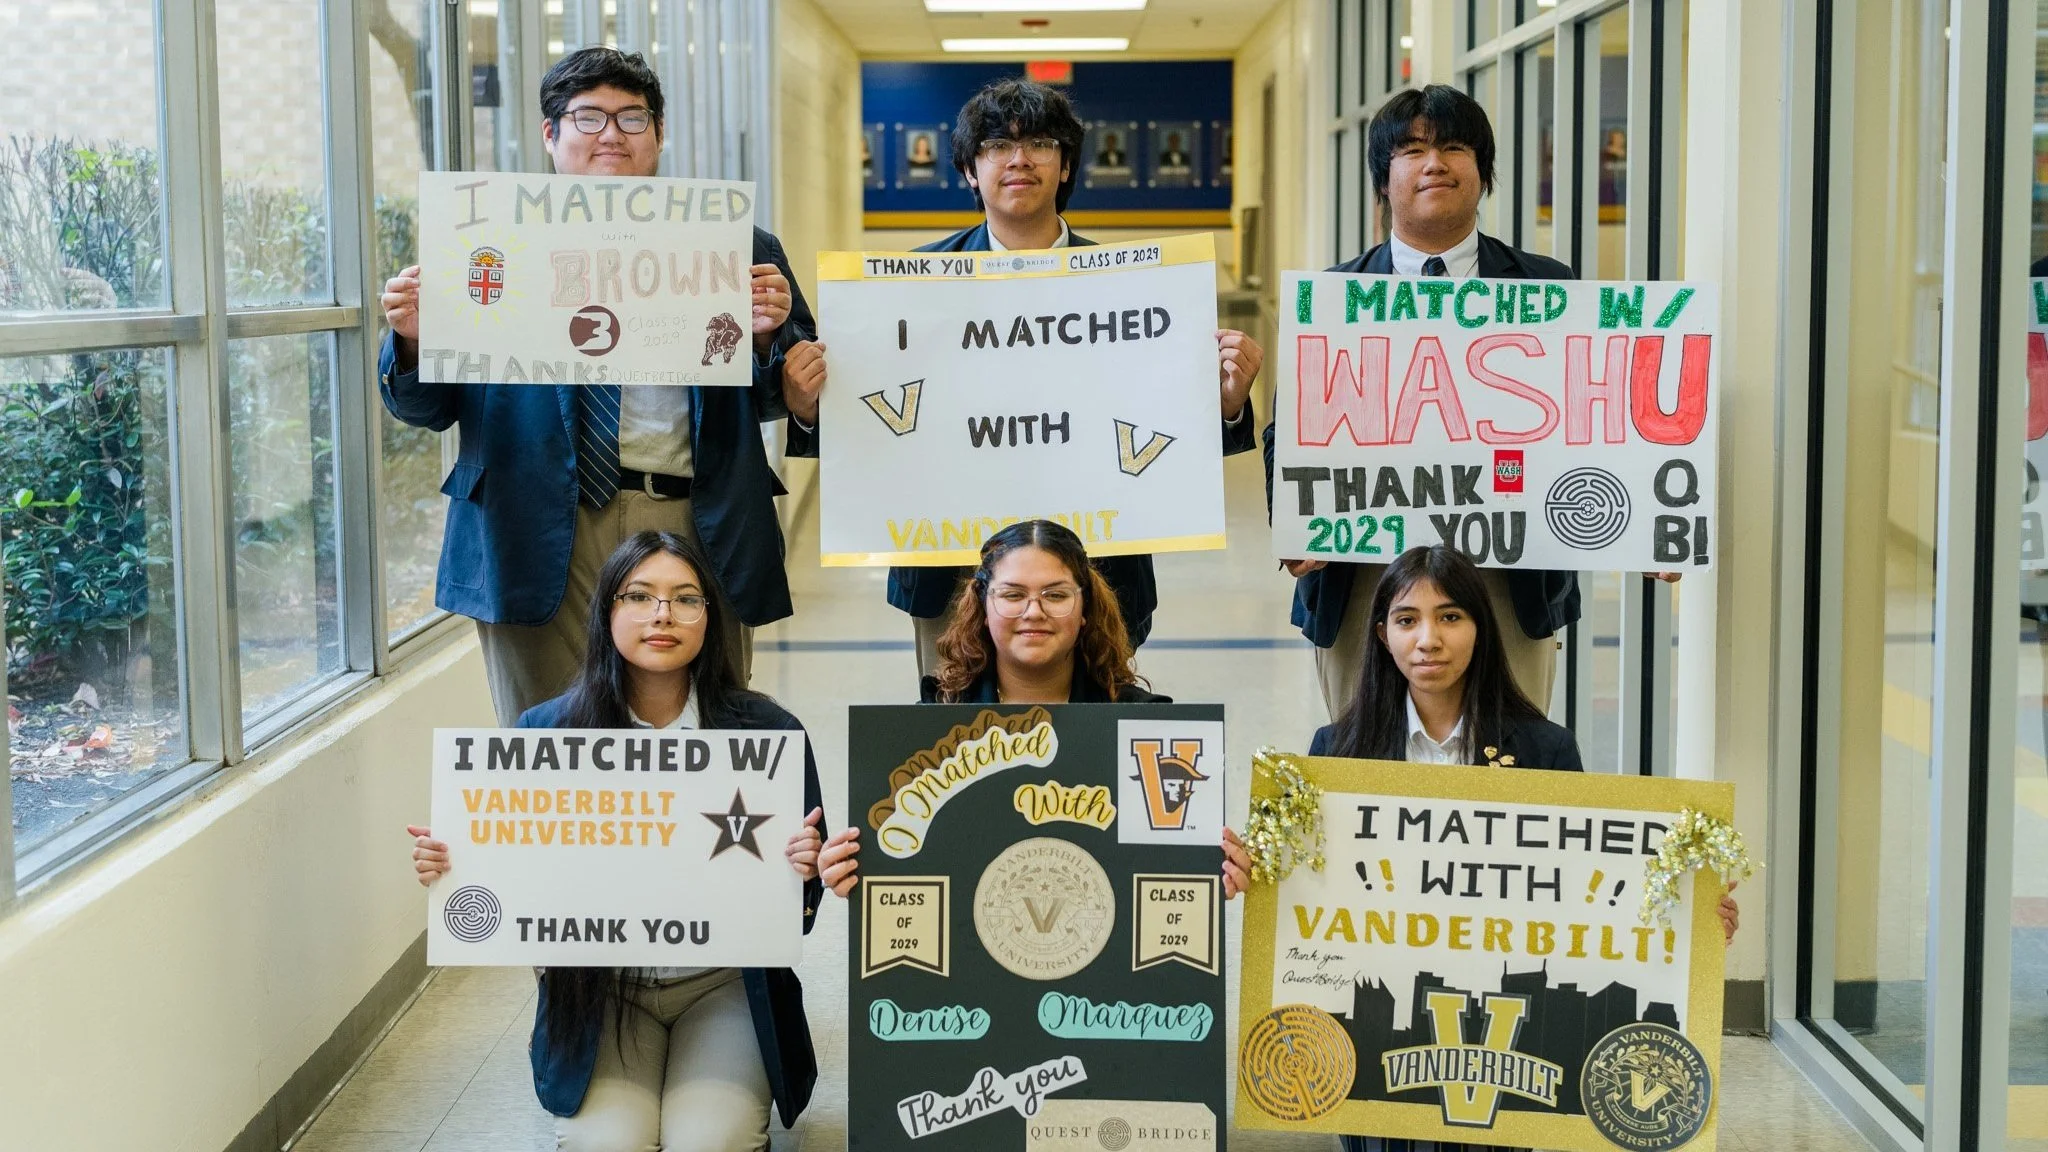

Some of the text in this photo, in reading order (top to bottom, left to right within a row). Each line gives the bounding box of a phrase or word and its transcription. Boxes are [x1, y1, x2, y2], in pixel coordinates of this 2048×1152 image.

[455, 180, 750, 229] I MATCHED
[602, 231, 636, 241] with
[550, 249, 741, 307] BROWN
[867, 258, 974, 275] THANK YOU
[1070, 247, 1159, 270] CLASS OF 2029
[628, 314, 689, 333] Class of
[1297, 280, 1312, 324] I
[1345, 279, 1567, 329] MATCHED
[642, 331, 680, 348] 2029
[898, 306, 1171, 350] I MATCHED
[422, 349, 607, 384] THANKS
[858, 378, 925, 437] V
[1297, 333, 1713, 446] WASHU
[967, 411, 1070, 448] WITH
[1112, 418, 1178, 477] V
[1281, 464, 1485, 516] THANK
[1496, 466, 1522, 476] WASH
[1653, 459, 1700, 508] Q
[1306, 511, 1526, 565] 2029 YOU
[1653, 514, 1710, 566] B!
[455, 735, 787, 780] I MATCHED W/
[900, 725, 1050, 819] Matched
[462, 788, 675, 817] VANDERBILT
[1018, 784, 1112, 824] With
[470, 820, 677, 847] UNIVERSITY
[726, 815, 749, 843] V
[1354, 805, 1669, 856] I MATCHED
[997, 847, 1093, 875] VANDERBILT
[1421, 860, 1561, 902] WITH
[879, 893, 925, 906] CLASS
[1149, 889, 1195, 903] CLASS
[516, 917, 711, 945] THANK YOU
[897, 917, 912, 929] OF
[1166, 913, 1182, 925] OF
[1292, 905, 1676, 965] VANDERBILT!
[890, 938, 919, 950] 2029
[998, 942, 1089, 970] UNIVERSITY
[1160, 934, 1188, 946] 2029
[1286, 947, 1346, 970] Thank you
[870, 993, 1210, 1040] Denise Marquez
[1385, 1048, 1561, 1101] VANDERBILT
[1619, 1031, 1704, 1079] VANDERBILT
[900, 1059, 1078, 1137] Thank you
[1630, 1070, 1672, 1112] V
[1030, 1126, 1212, 1140] QUEST BRIDGE
[1592, 1100, 1673, 1147] UNIVERSITY
